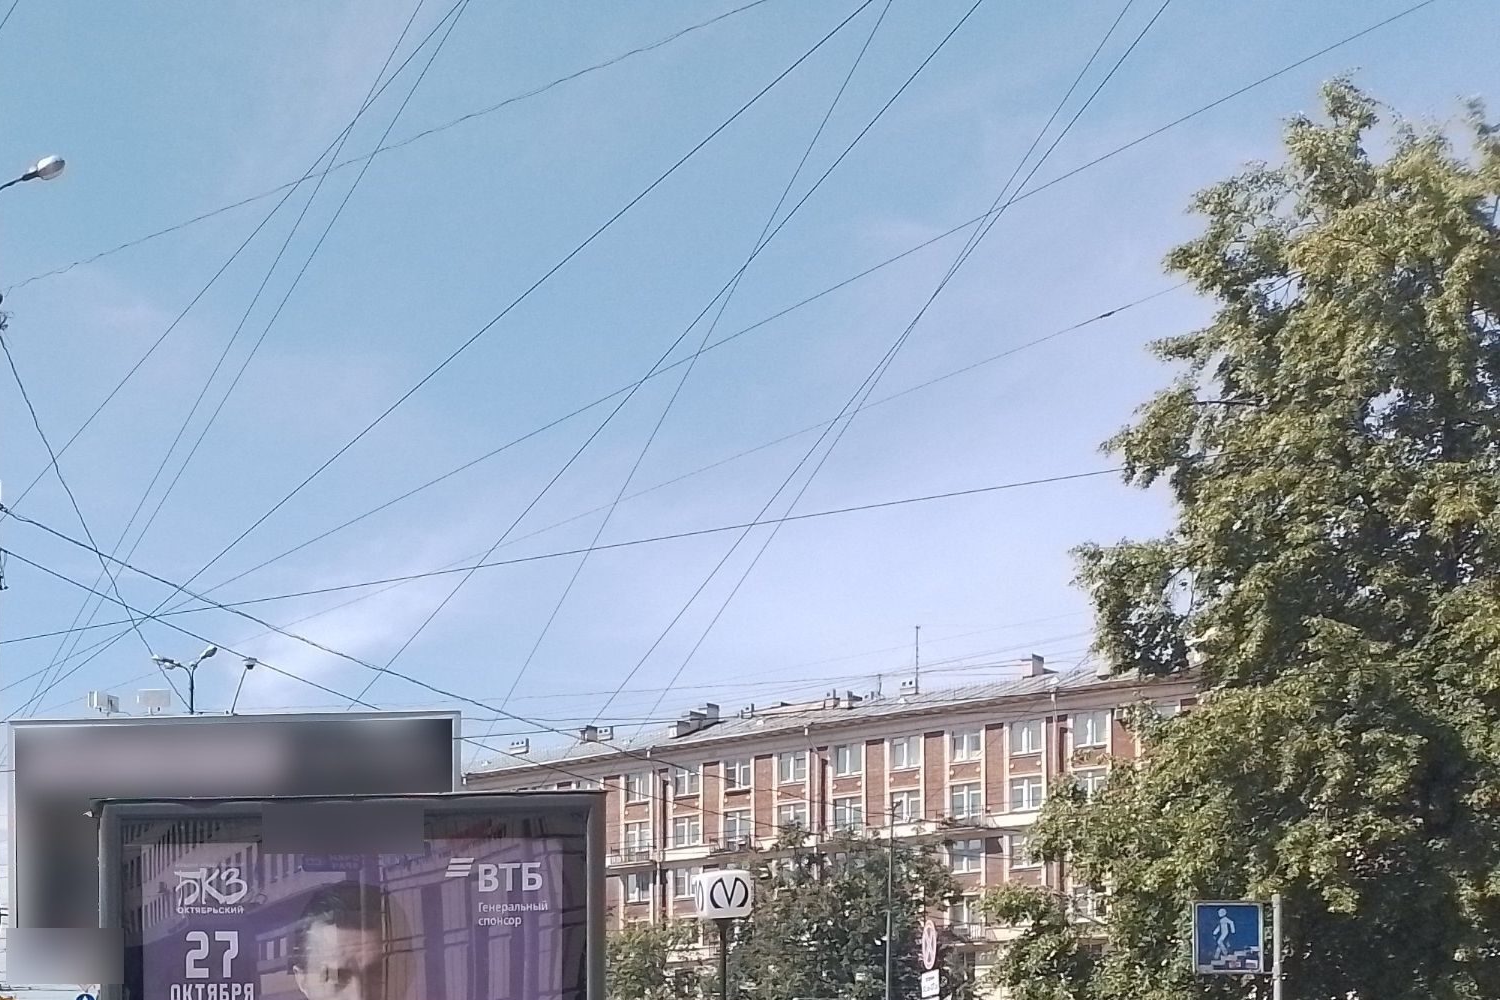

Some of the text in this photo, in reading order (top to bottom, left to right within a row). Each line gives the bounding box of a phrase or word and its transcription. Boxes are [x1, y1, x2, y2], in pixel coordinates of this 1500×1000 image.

[174, 868, 248, 907] БКЗ
[478, 862, 543, 893] ВТБ
[177, 905, 244, 915] ОКТЯБРЬСКИЙ
[478, 900, 549, 915] Генеральный
[478, 916, 522, 928] спонсор
[185, 930, 239, 979] 27
